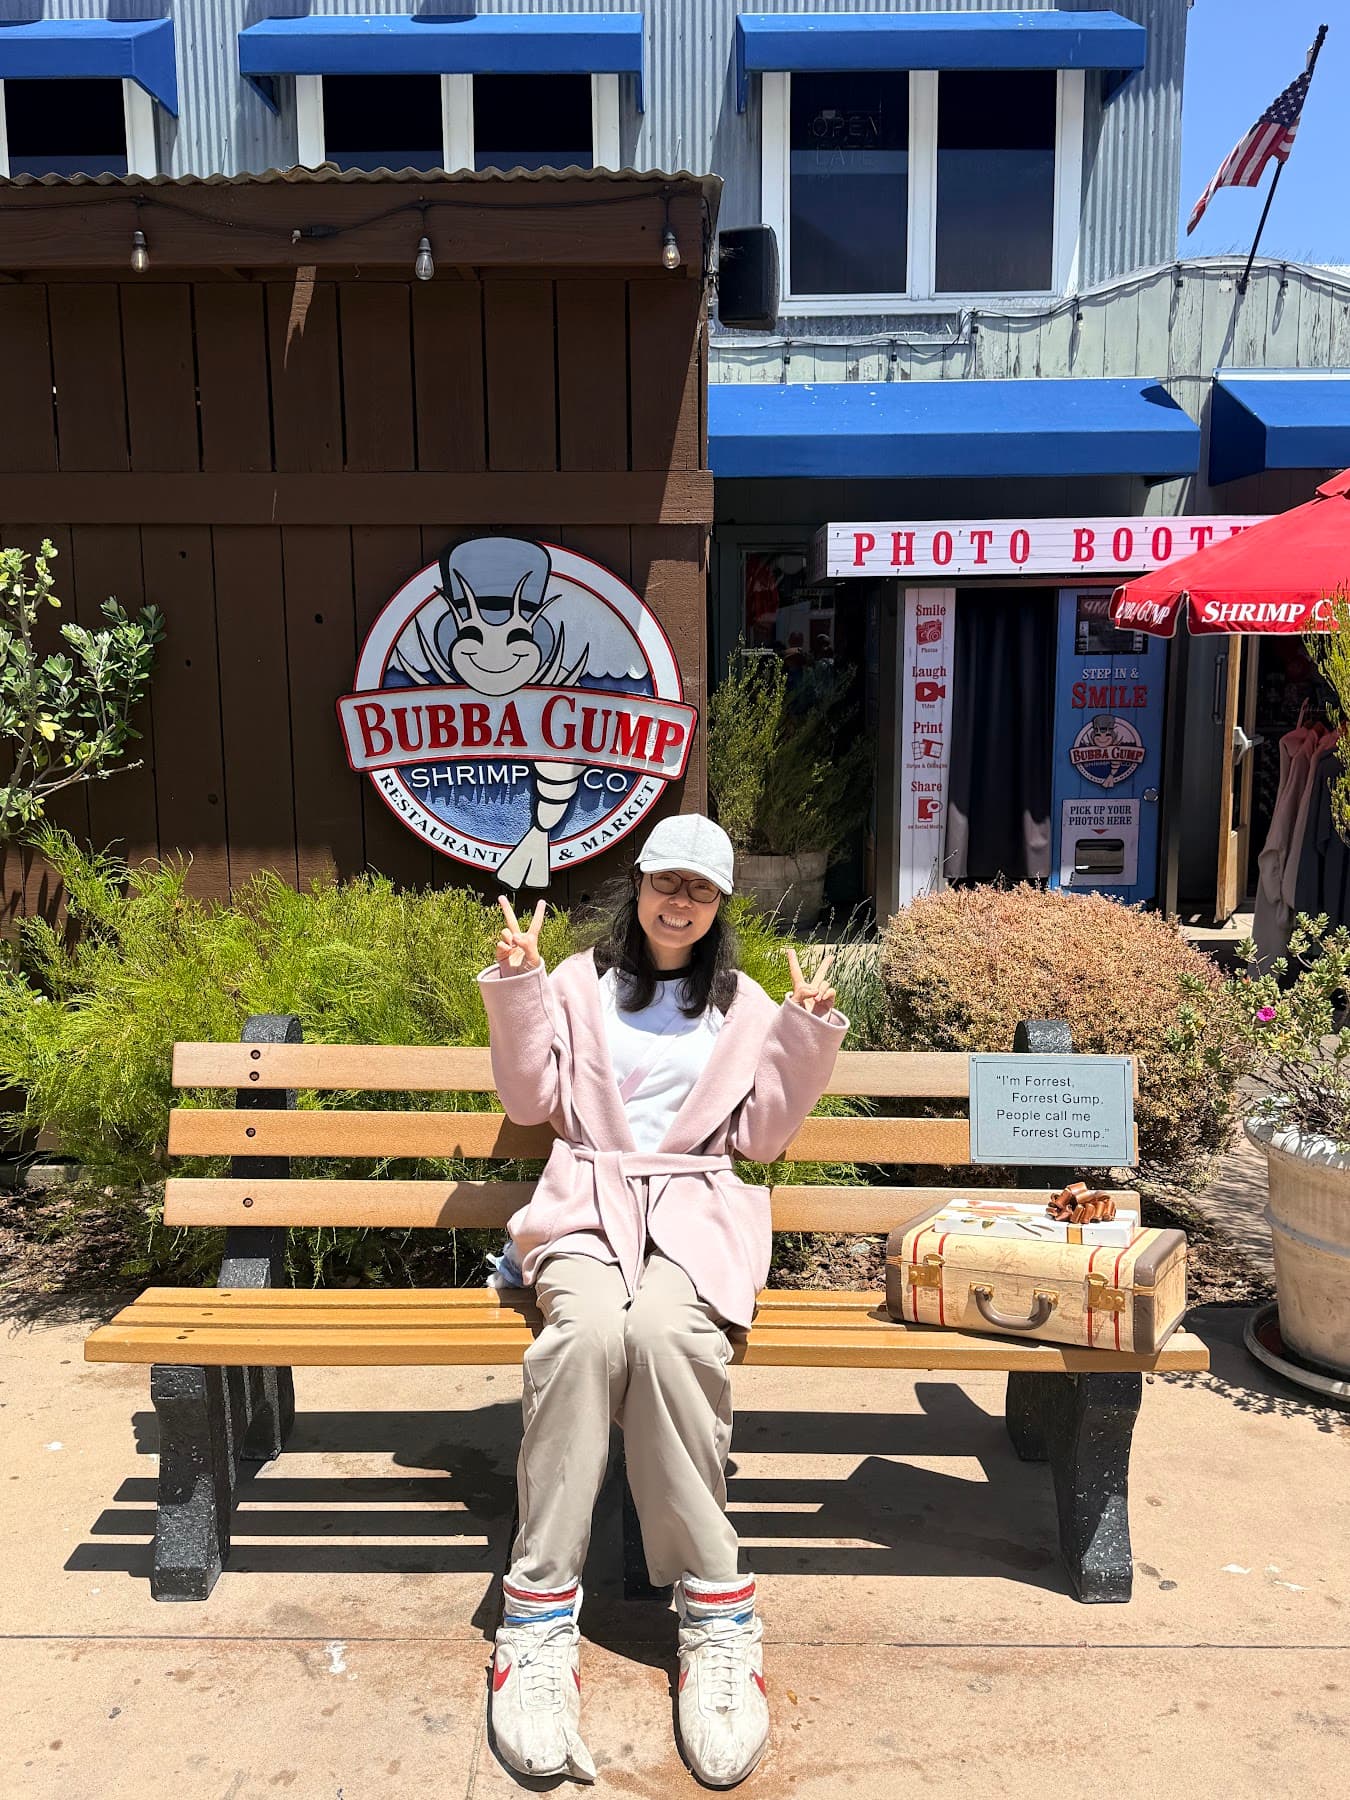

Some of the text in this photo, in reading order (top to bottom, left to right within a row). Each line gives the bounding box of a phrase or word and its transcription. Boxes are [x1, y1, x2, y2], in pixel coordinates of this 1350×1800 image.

[853, 529, 1030, 566] PHOTO
[1072, 525, 1254, 562] BOOT
[916, 604, 946, 616] Smile
[1201, 600, 1306, 623] SHRIMP
[912, 666, 946, 679] Laugh
[1082, 667, 1139, 680] STEP IN &
[1072, 682, 1147, 709] SMILE
[353, 694, 685, 764] BUBBA GUMP
[913, 721, 943, 733] Print
[1073, 747, 1143, 763] BUBBA GUMP
[411, 766, 529, 788] SHRIMP
[911, 781, 942, 792] Share
[1070, 805, 1132, 815] PICK UP YOUR
[380, 774, 655, 864] RESTAURANT & MARKET
[1069, 816, 1132, 826] PHOTOS HERE
[1012, 1093, 1104, 1106] Forrest Gump.
[997, 1110, 1091, 1122] People call me
[1013, 1127, 1059, 1138] Forrest
